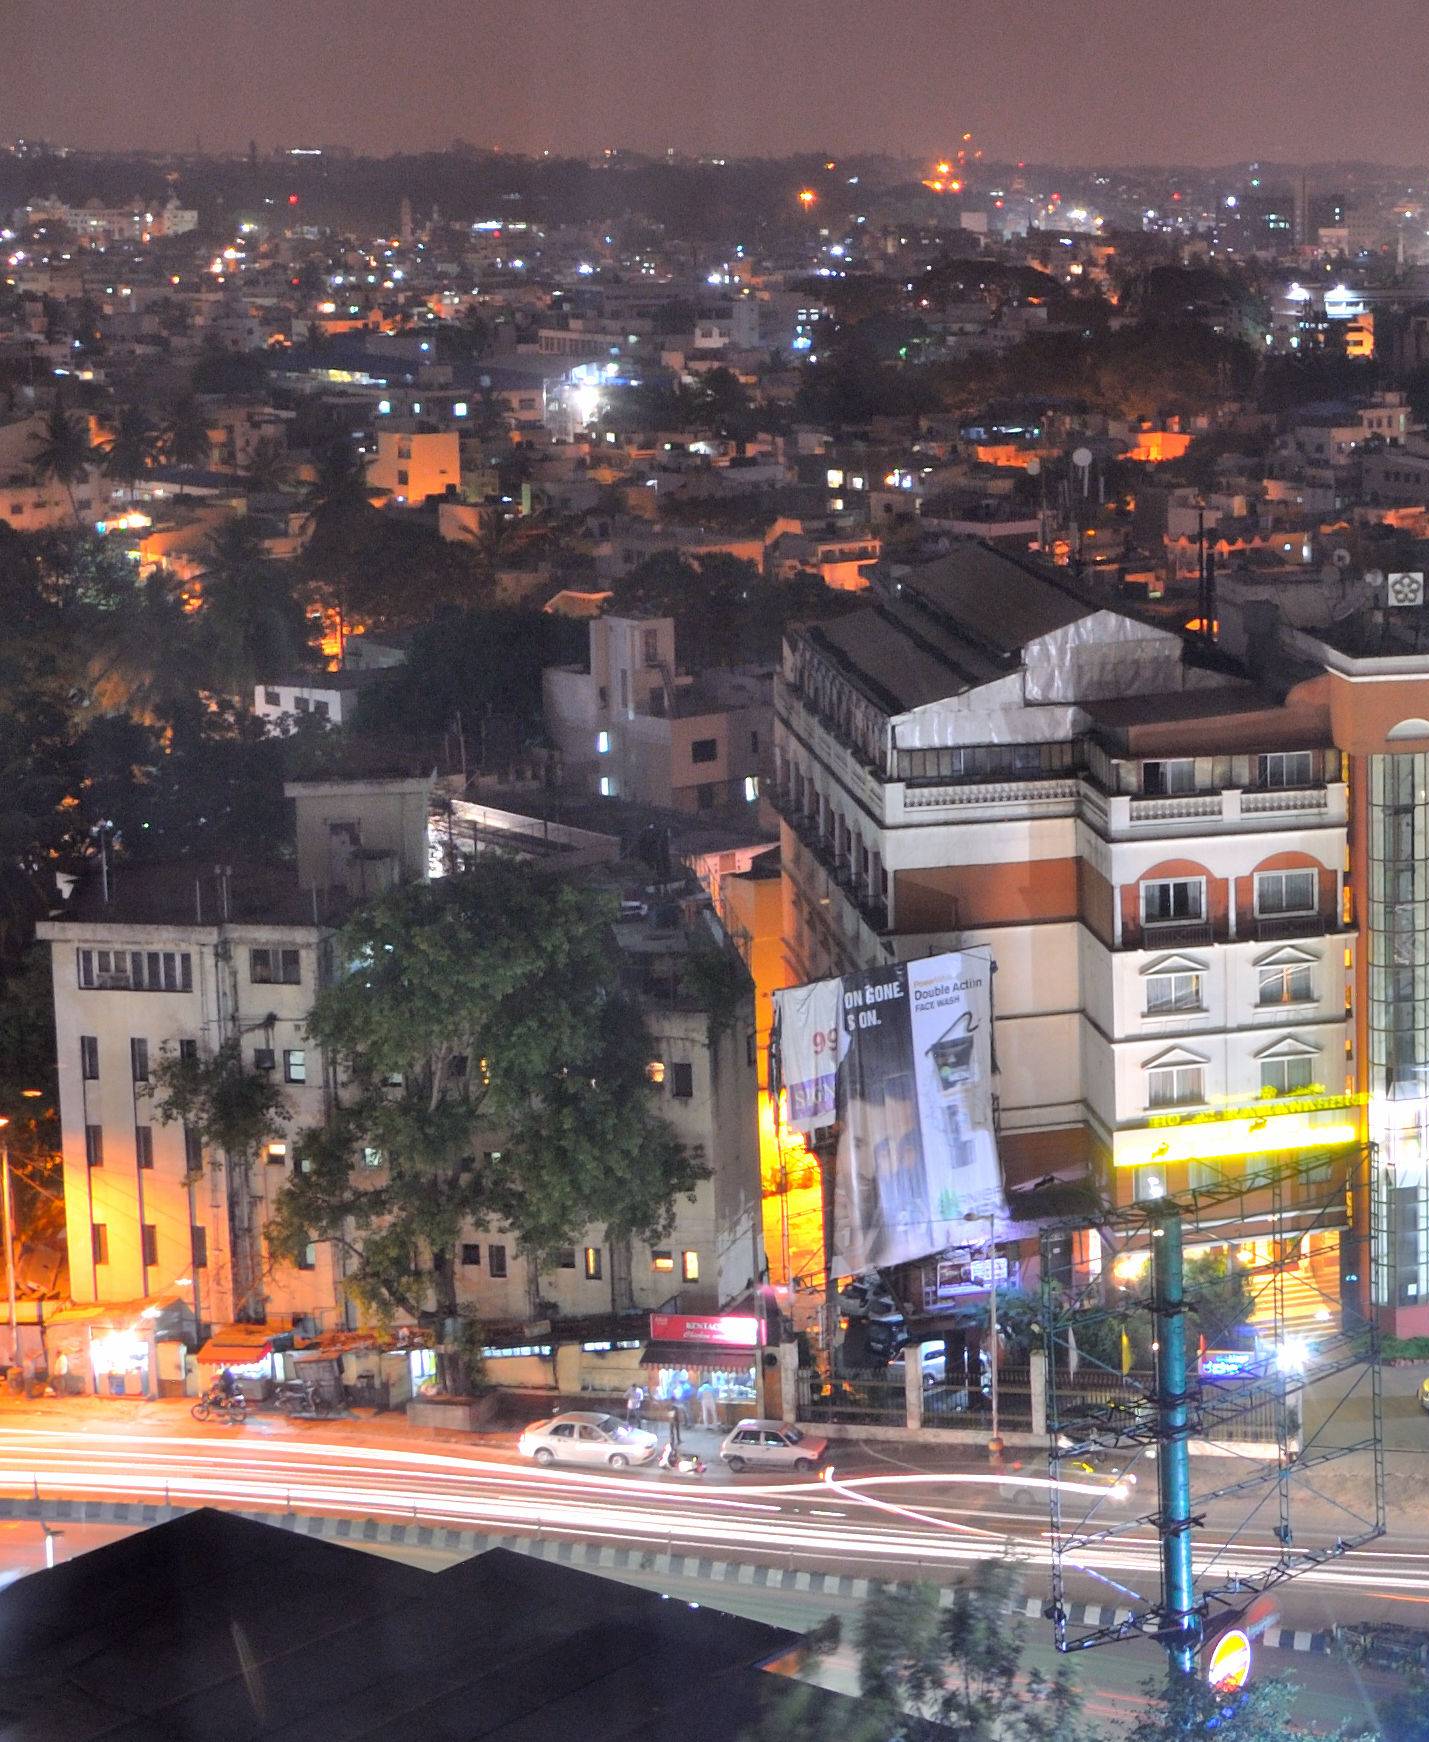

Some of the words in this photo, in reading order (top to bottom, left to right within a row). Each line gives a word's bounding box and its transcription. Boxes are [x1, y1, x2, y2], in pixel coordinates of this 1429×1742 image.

[914, 984, 950, 1001] Double
[915, 1001, 936, 1013] FACE
[937, 996, 961, 1008] WASH
